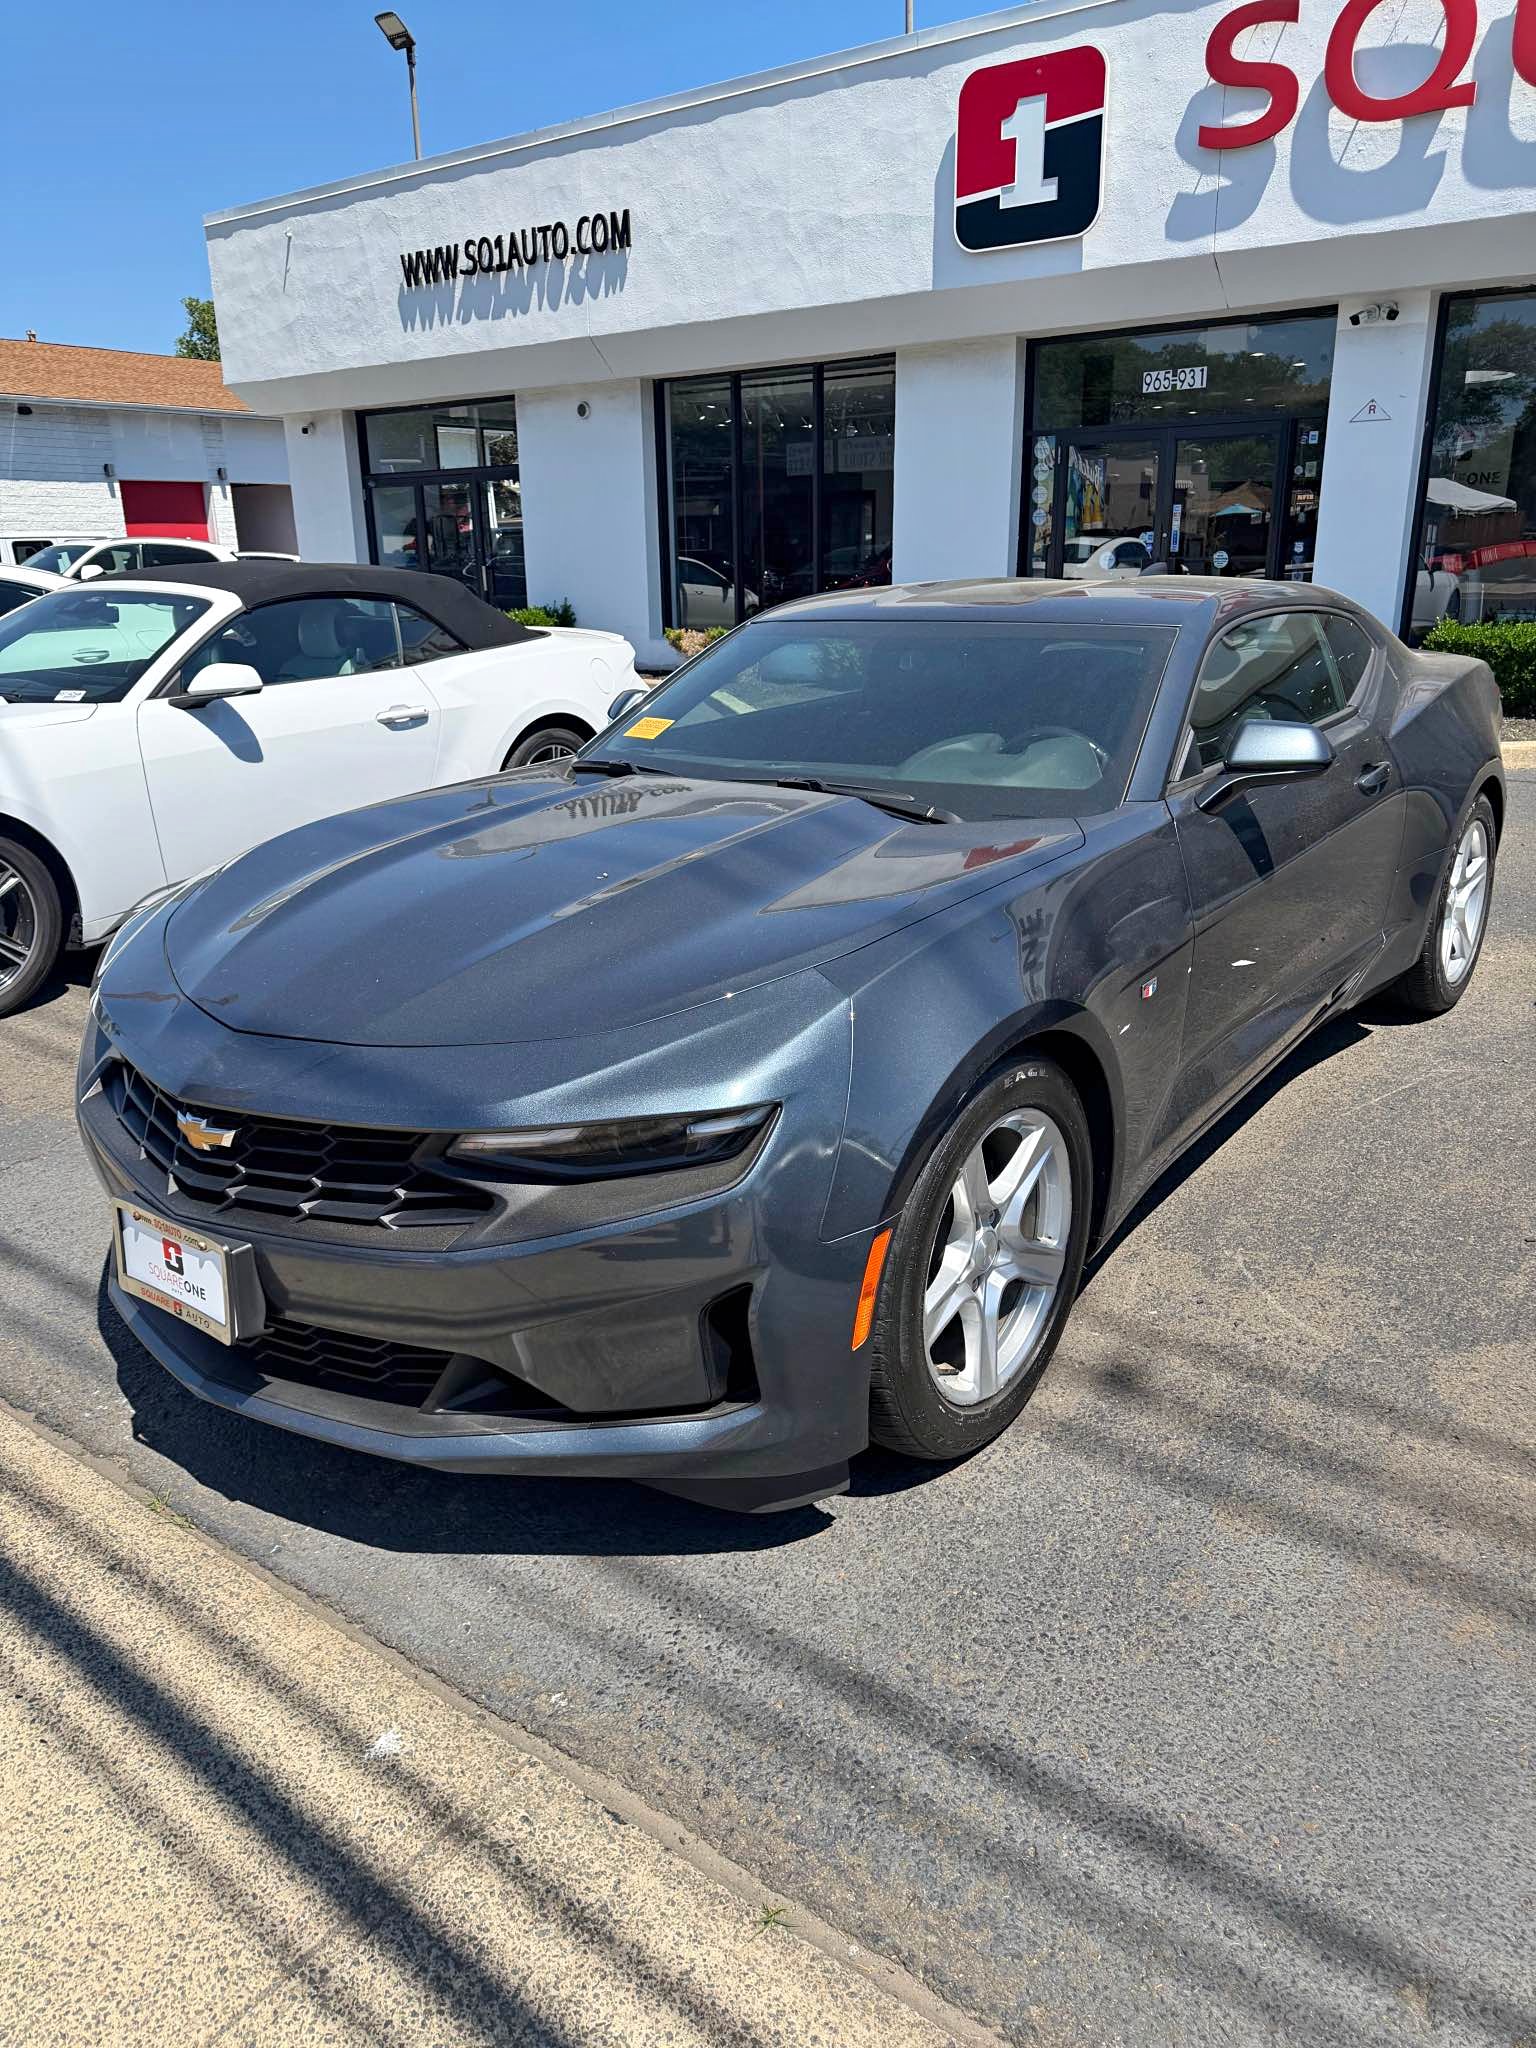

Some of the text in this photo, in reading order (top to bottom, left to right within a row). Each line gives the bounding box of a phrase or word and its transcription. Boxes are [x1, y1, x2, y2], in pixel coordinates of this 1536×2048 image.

[1198, 0, 1536, 149] SQ
[1000, 93, 1058, 209] 1
[400, 209, 632, 288] WWW.SQ1AUTO.COM
[1144, 368, 1205, 392] 965-931
[1368, 404, 1377, 415] R
[1004, 1067, 1050, 1089] EAGL
[140, 1287, 171, 1308] SQUARE
[185, 1311, 210, 1329] AUTO
